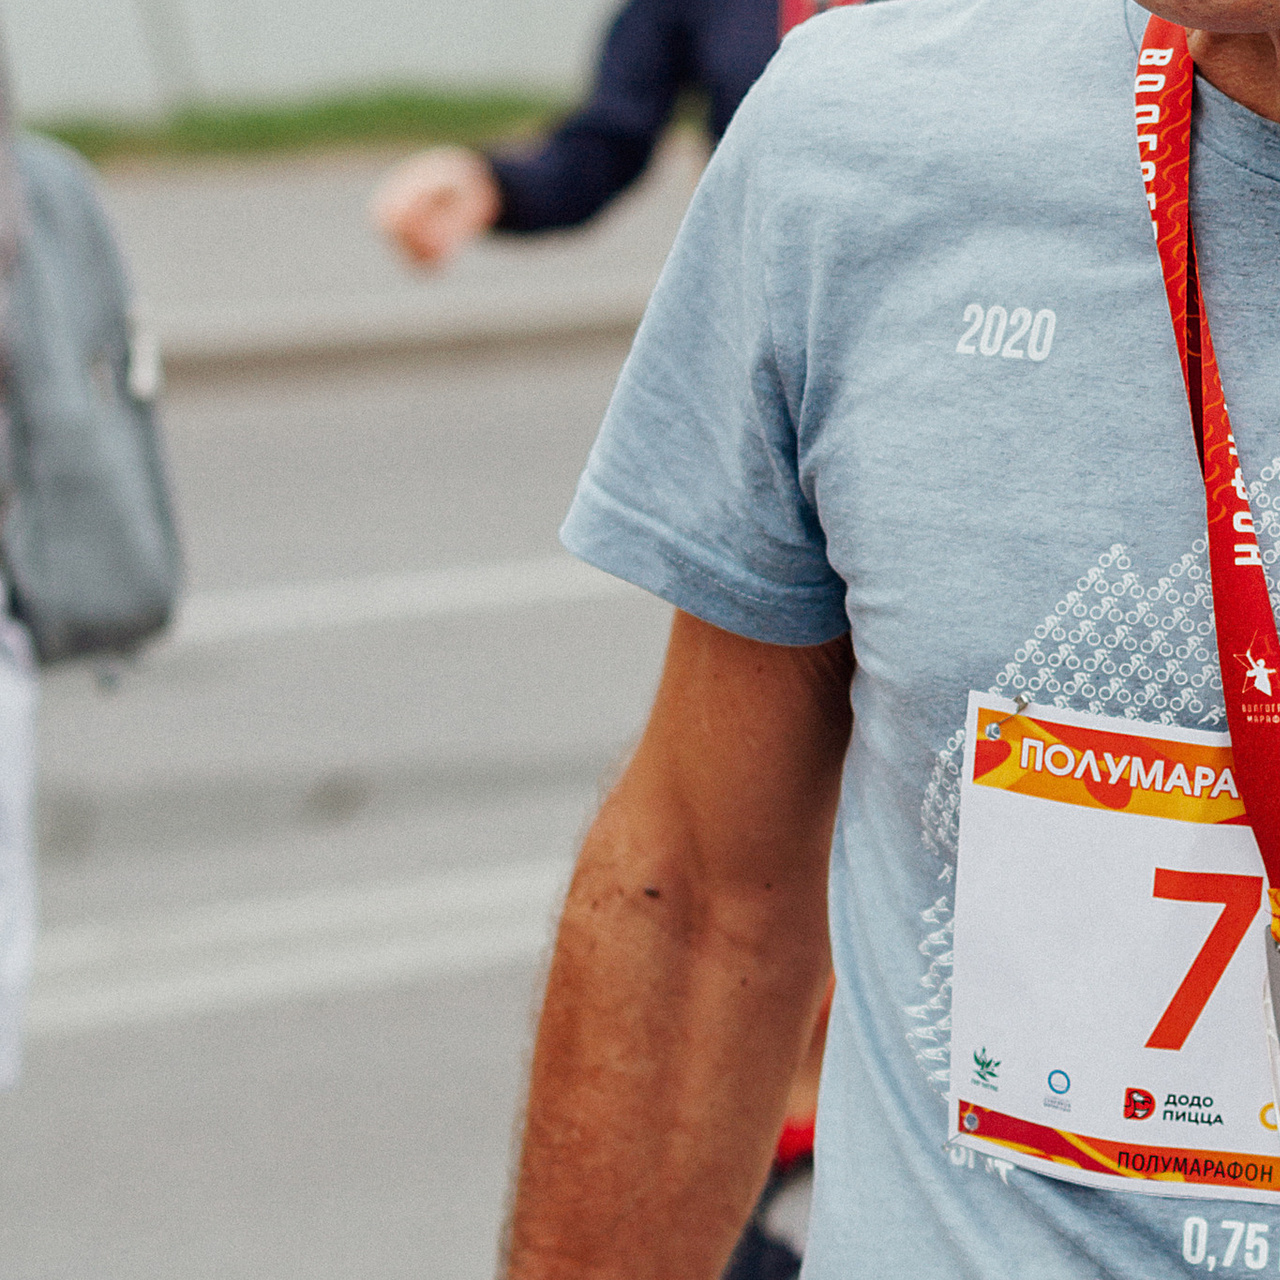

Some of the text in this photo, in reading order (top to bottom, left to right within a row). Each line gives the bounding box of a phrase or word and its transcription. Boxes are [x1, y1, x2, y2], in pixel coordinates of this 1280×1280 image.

[956, 304, 1057, 362] 2020
[1019, 736, 1240, 800] ПОЛУМАРА
[1162, 1109, 1225, 1127] ПИЦЦА
[1164, 1093, 1214, 1108] ДОДО
[1117, 1150, 1274, 1184] ПОЛУМАРАФОН
[1182, 1216, 1270, 1272] 0,75
